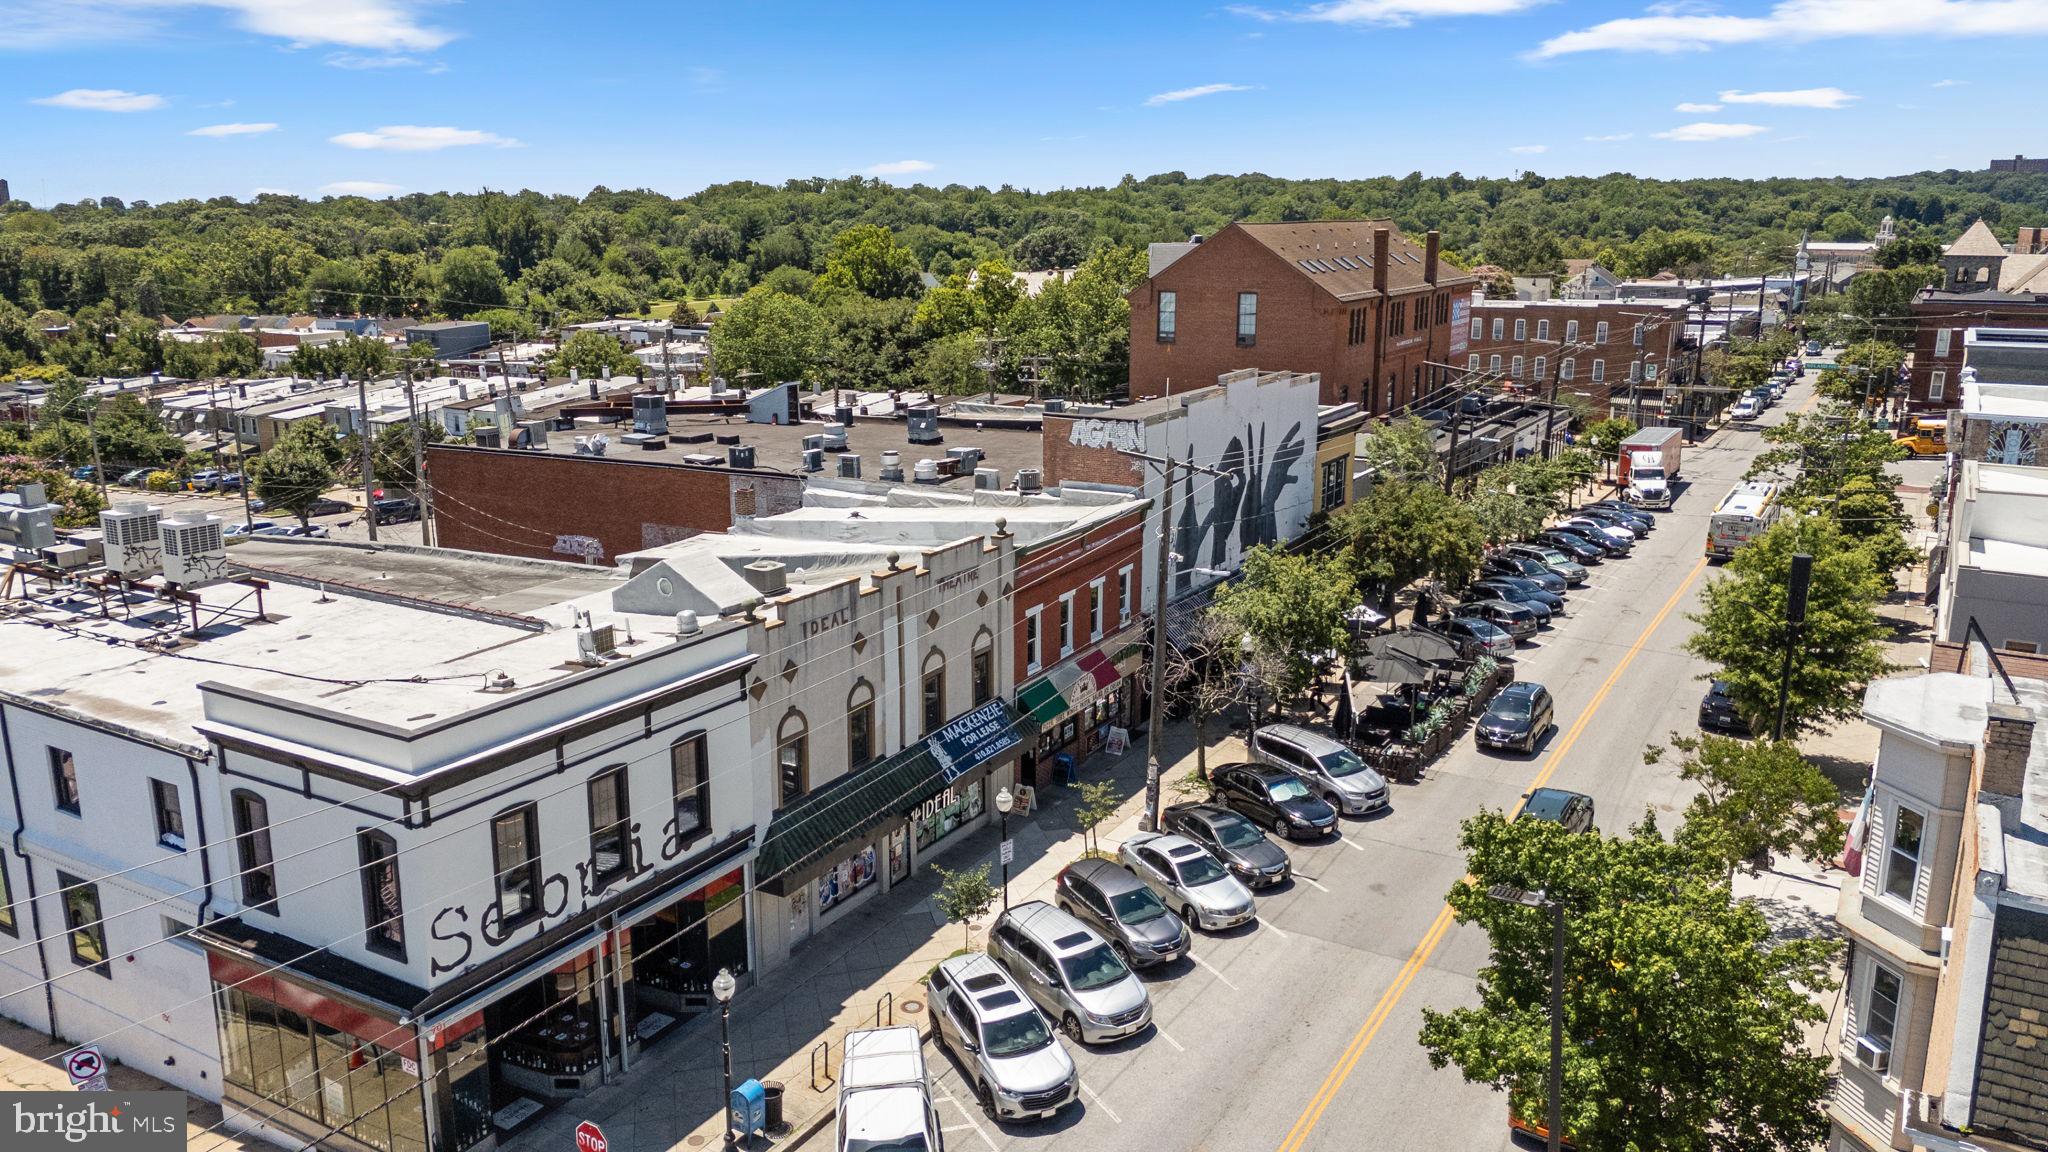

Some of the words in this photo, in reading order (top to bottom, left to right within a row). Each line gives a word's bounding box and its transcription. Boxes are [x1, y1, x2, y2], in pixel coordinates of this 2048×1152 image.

[1647, 365, 1656, 375] P
[802, 608, 849, 639] IDEAL
[942, 703, 1003, 742] MACKENZIE
[961, 732, 979, 747] FOR
[976, 720, 1001, 738] LEASE
[922, 786, 957, 820] IDEAL
[578, 1131, 605, 1152] STOP
